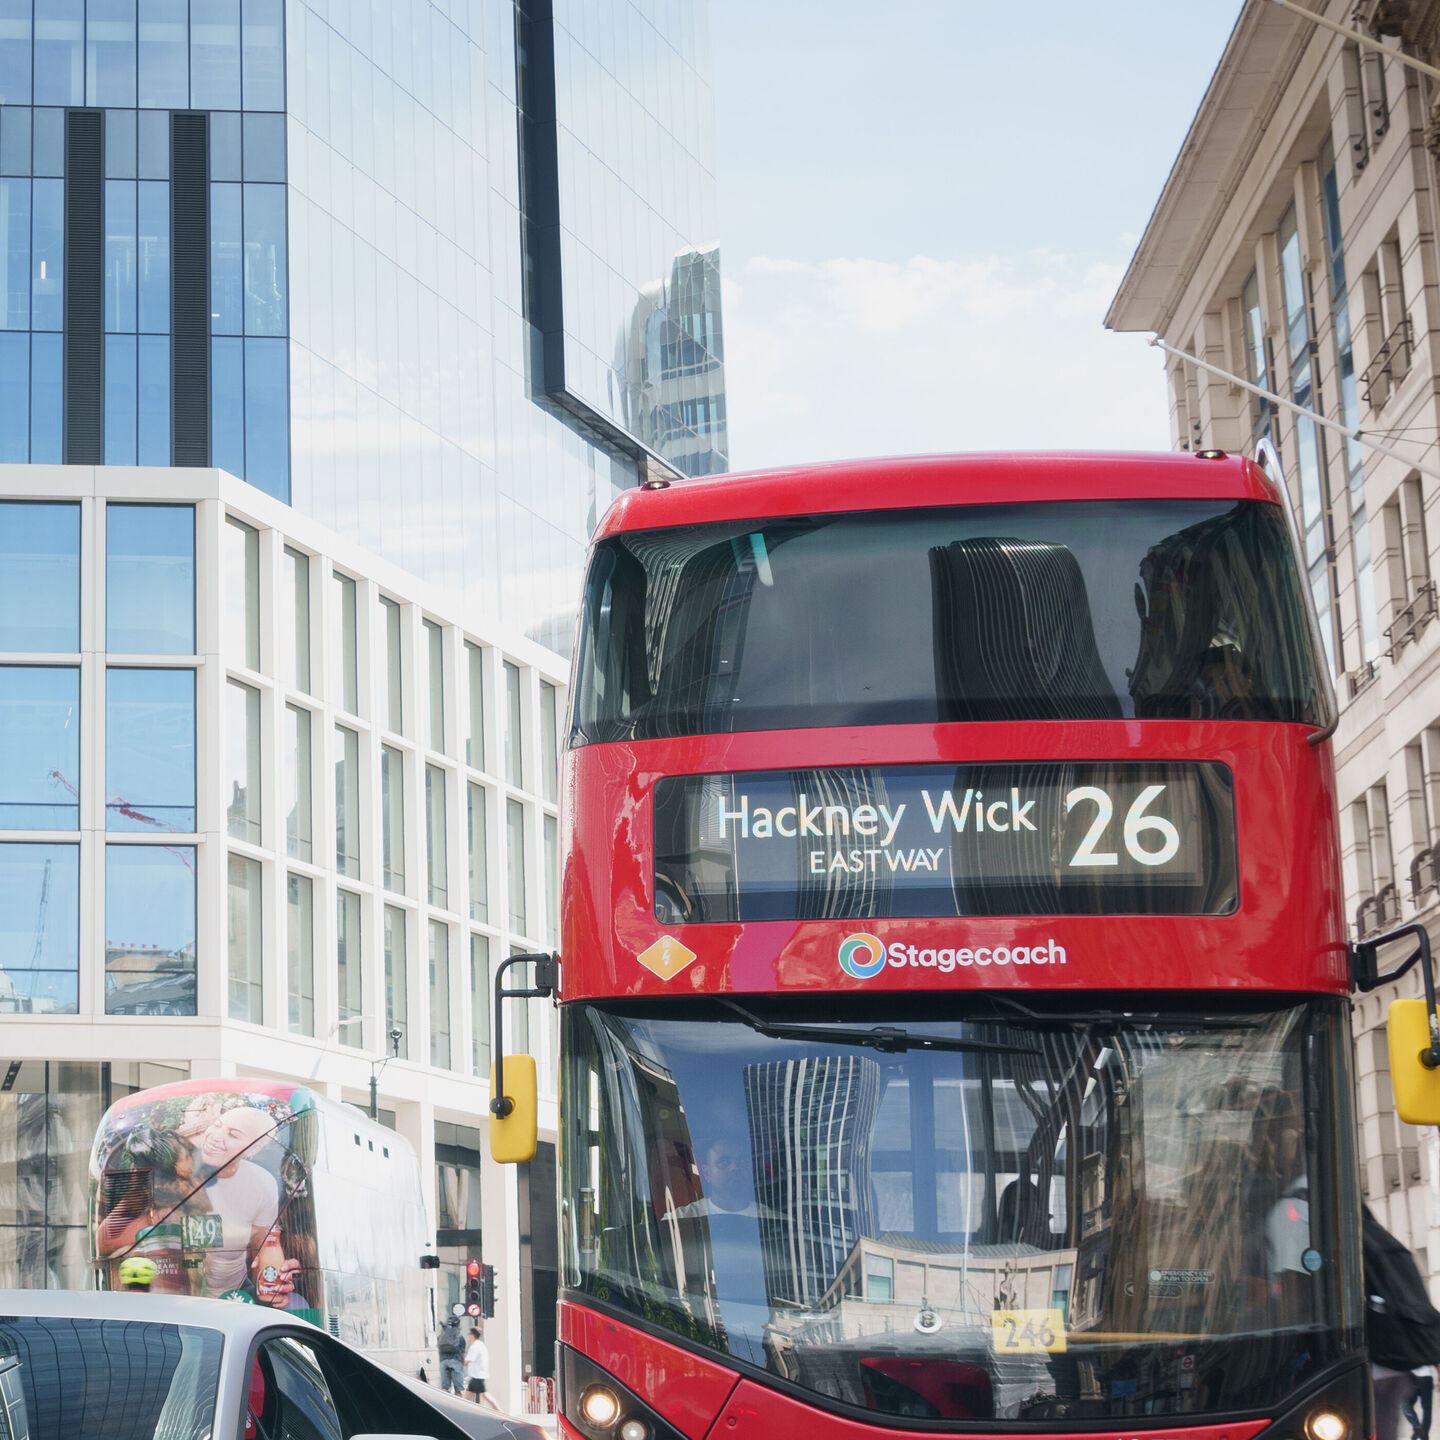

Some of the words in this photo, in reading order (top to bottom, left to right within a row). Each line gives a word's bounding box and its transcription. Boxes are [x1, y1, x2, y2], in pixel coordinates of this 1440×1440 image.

[718, 793, 907, 846] Hackney
[921, 787, 1038, 833] Wick
[1066, 785, 1180, 866] 26
[887, 939, 1067, 973] Stagecoach
[188, 1217, 217, 1246] 149
[1004, 1317, 1056, 1348] 246
